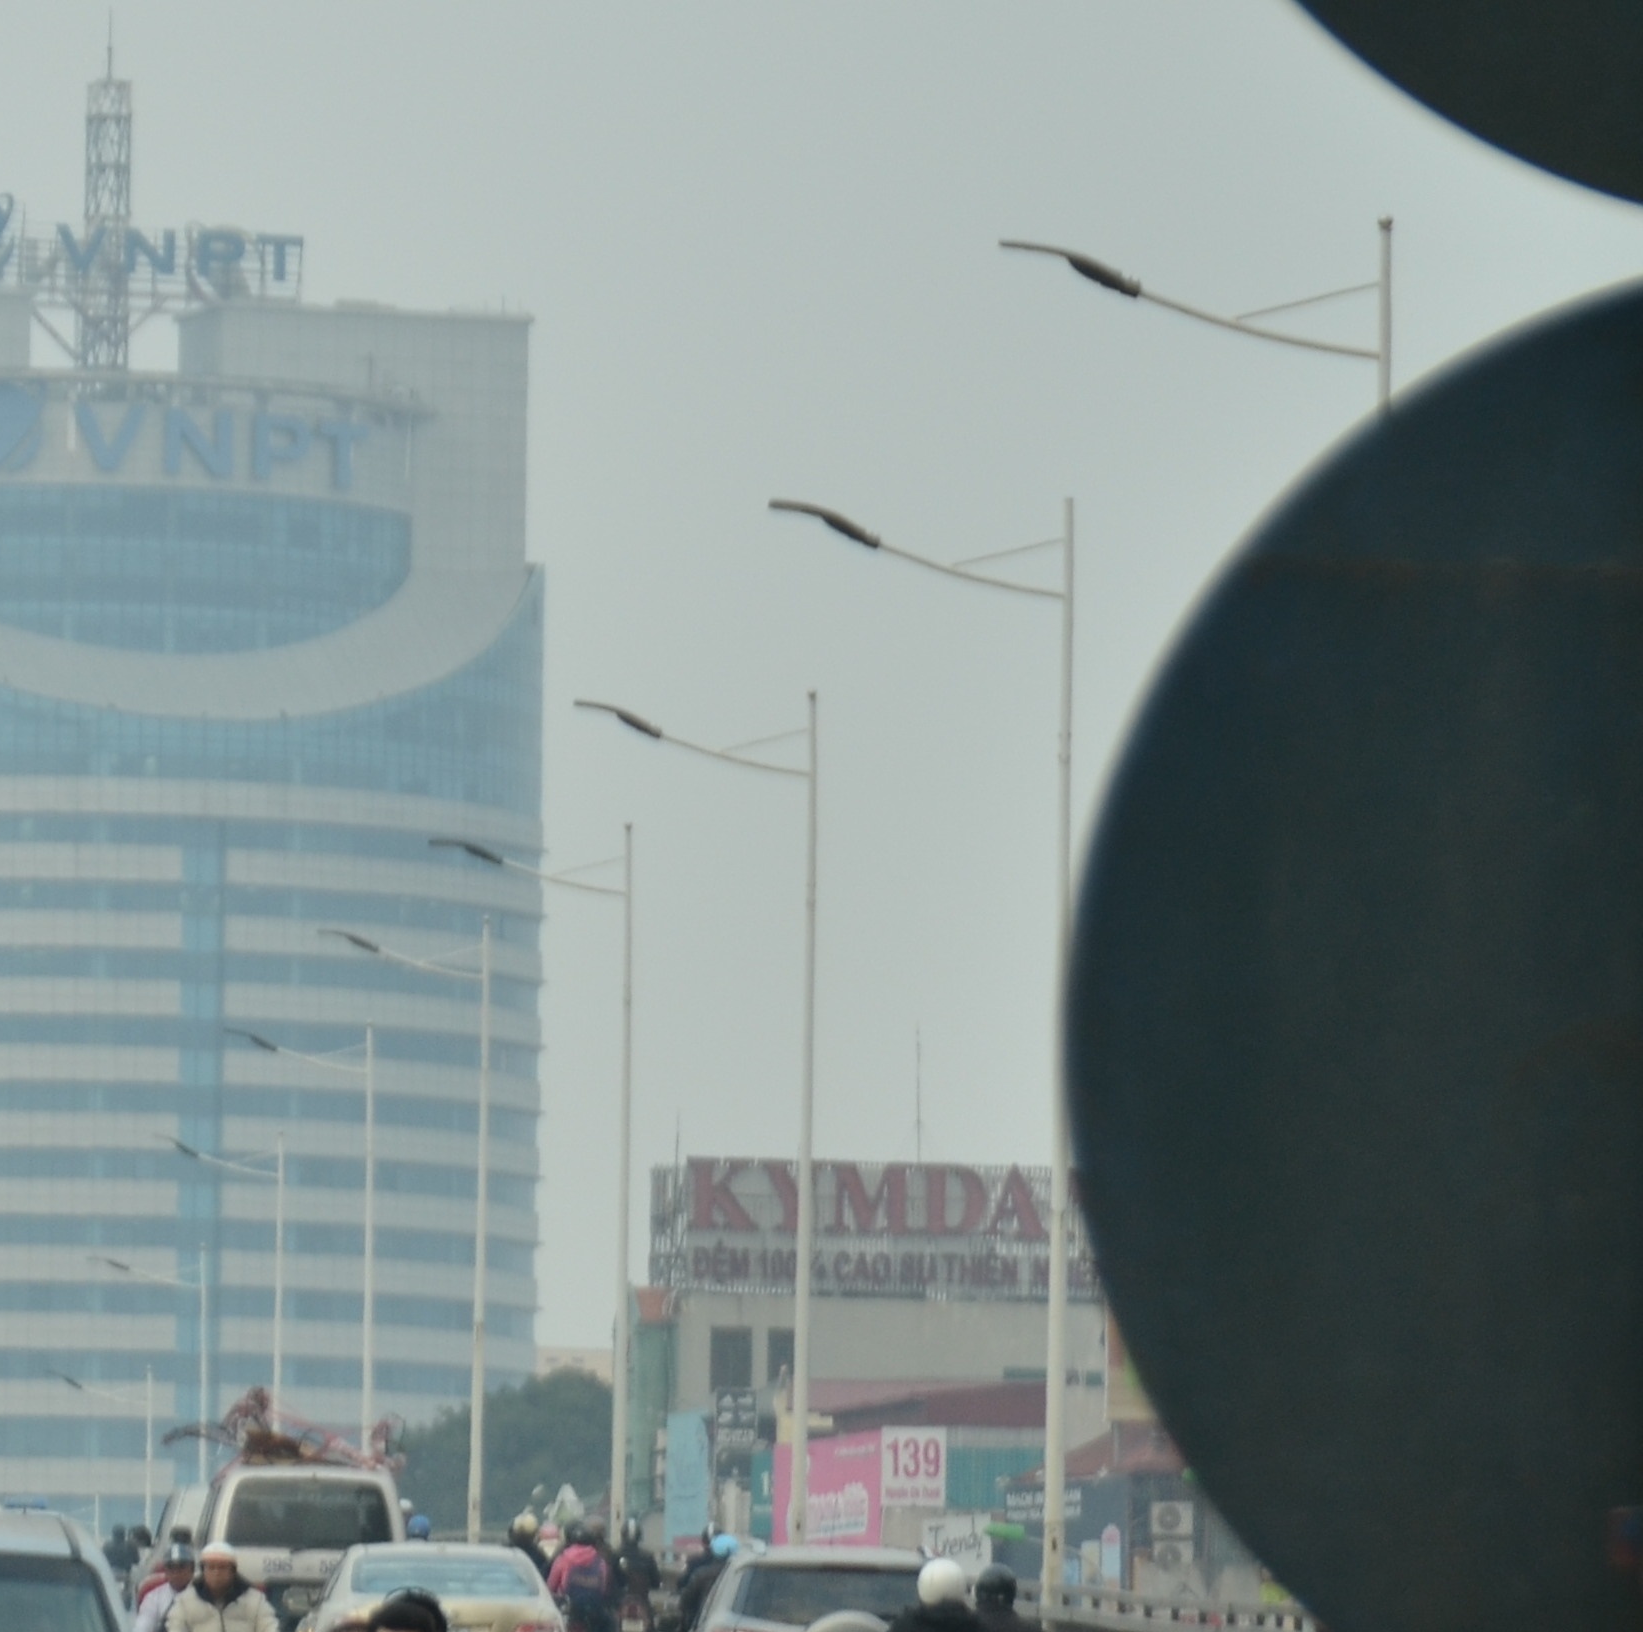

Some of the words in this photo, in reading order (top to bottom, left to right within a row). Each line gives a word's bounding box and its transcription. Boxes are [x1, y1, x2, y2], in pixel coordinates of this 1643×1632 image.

[57, 223, 304, 282] VNPT
[72, 399, 371, 490] VNPT
[687, 1156, 1083, 1240] KYMDA
[887, 1438, 941, 1478] 139
